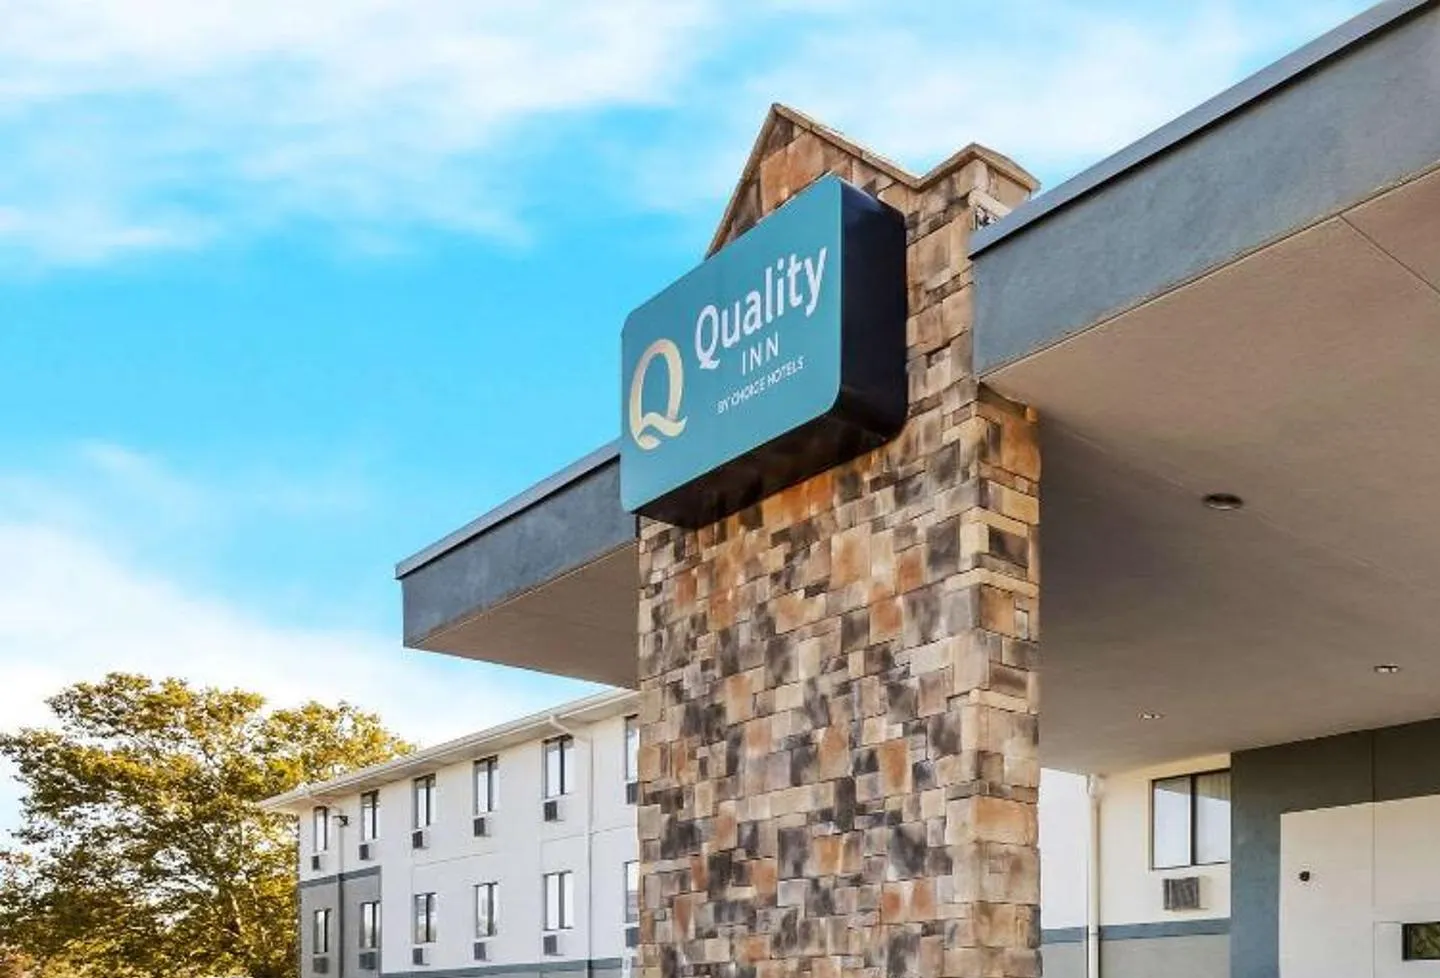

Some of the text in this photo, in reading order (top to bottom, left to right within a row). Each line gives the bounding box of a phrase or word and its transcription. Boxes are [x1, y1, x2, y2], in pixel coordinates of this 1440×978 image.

[695, 247, 827, 370] Quality
[629, 338, 688, 450] Q
[717, 355, 804, 414] BY CHOICE HOTELS
[742, 331, 779, 376] INN
